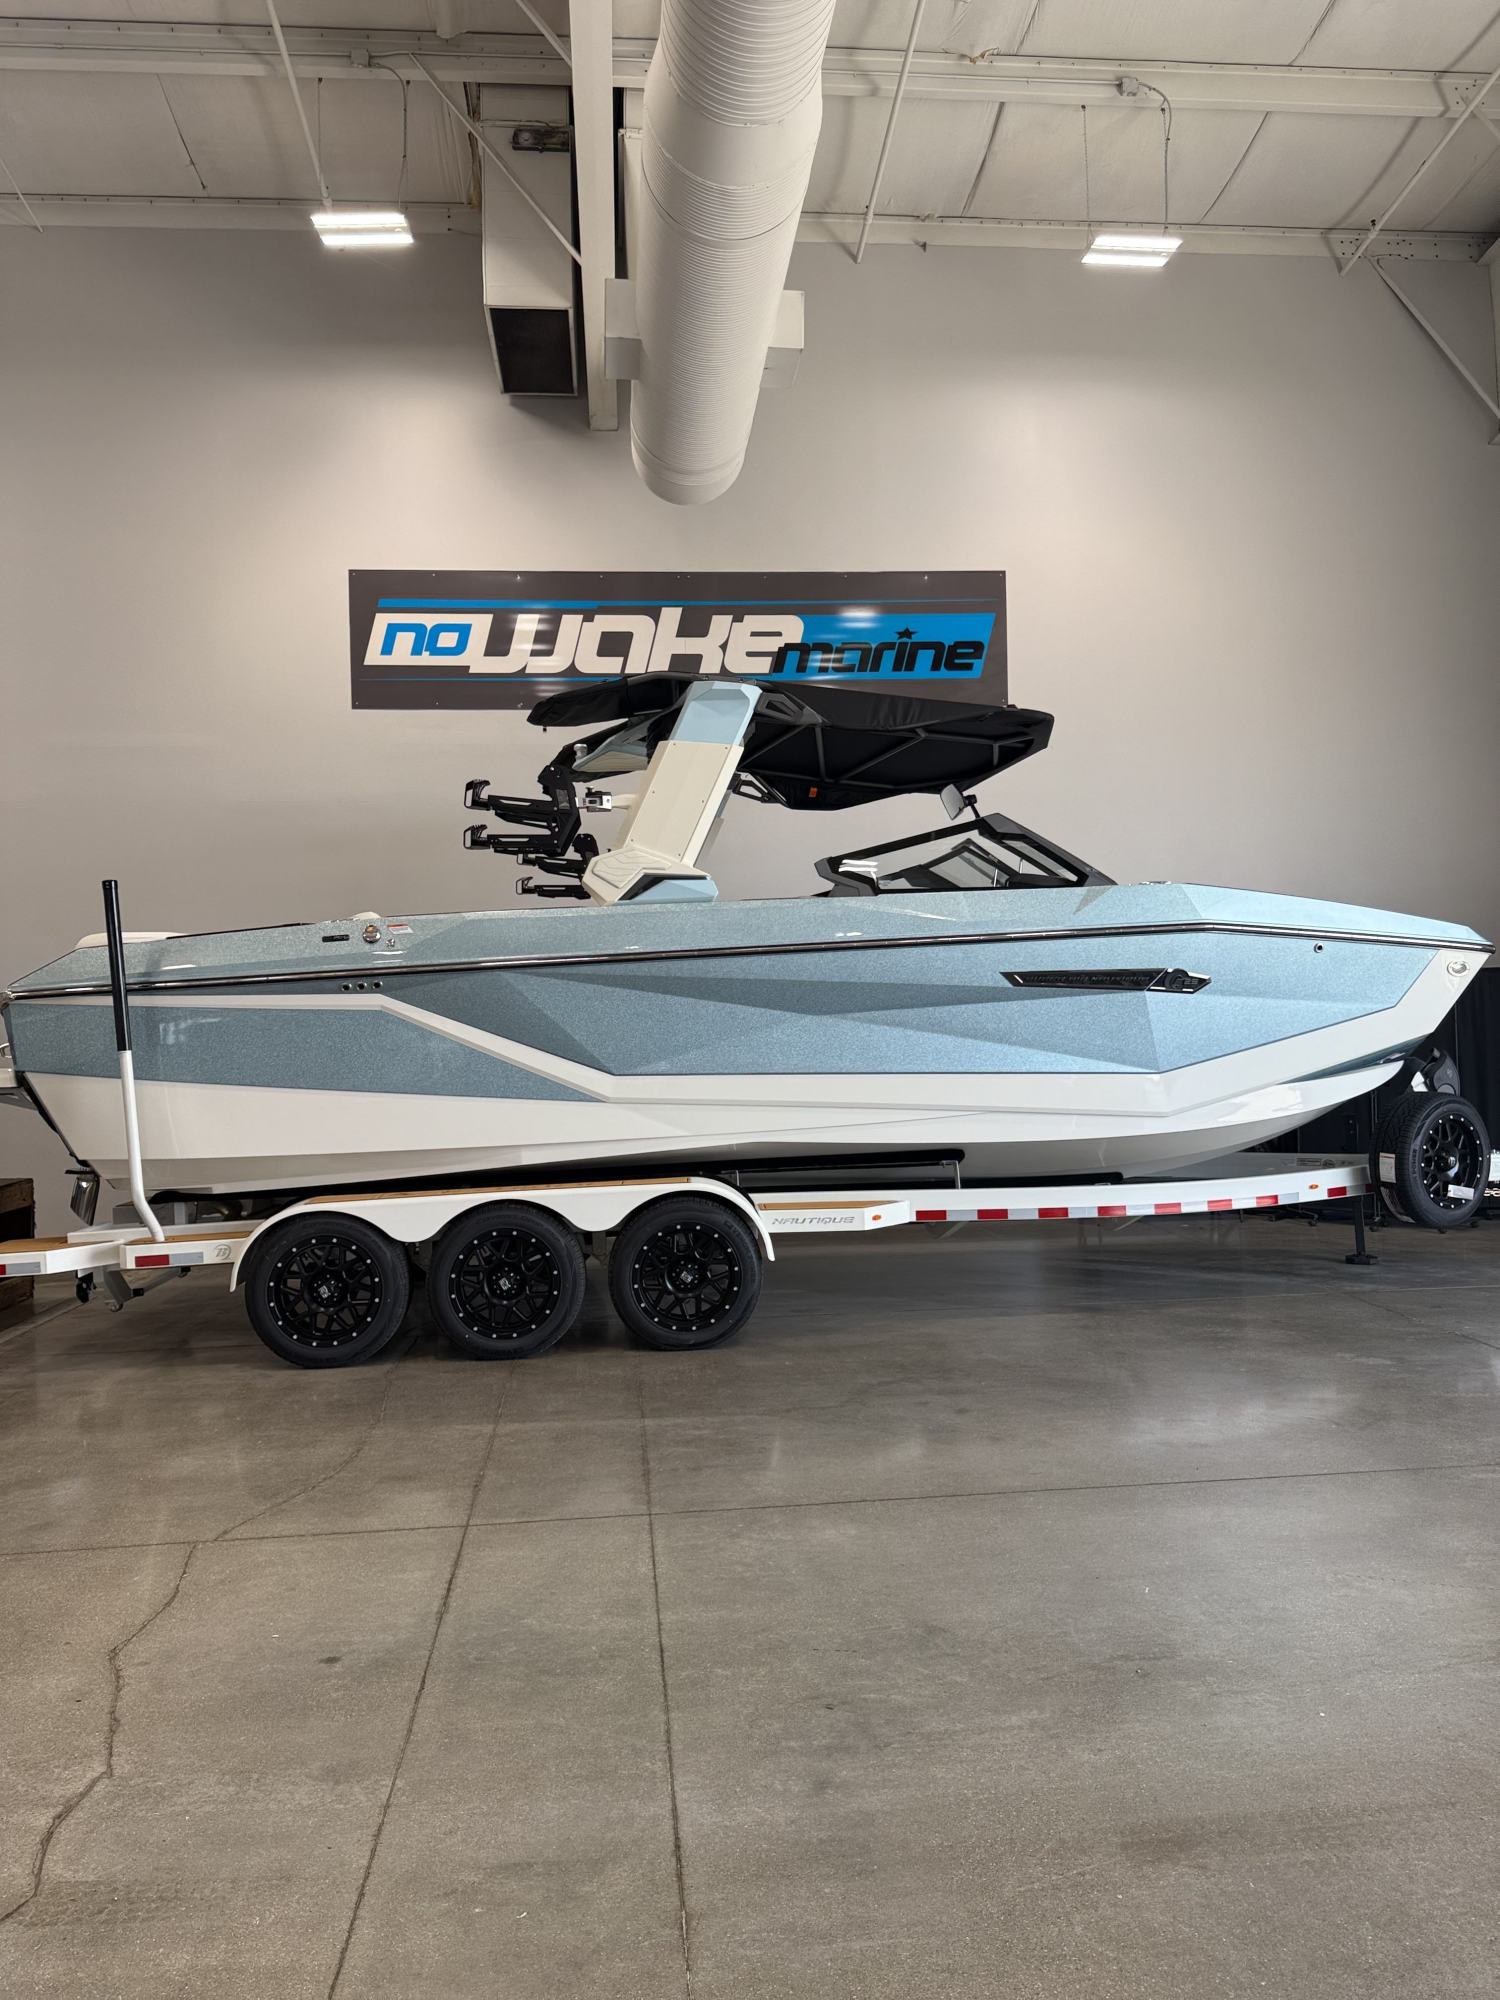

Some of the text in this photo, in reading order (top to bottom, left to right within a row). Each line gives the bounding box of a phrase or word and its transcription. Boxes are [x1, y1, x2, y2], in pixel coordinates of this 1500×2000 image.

[379, 622, 472, 657] no
[772, 627, 985, 674] marine
[771, 1216, 855, 1225] NAUTIQUE
